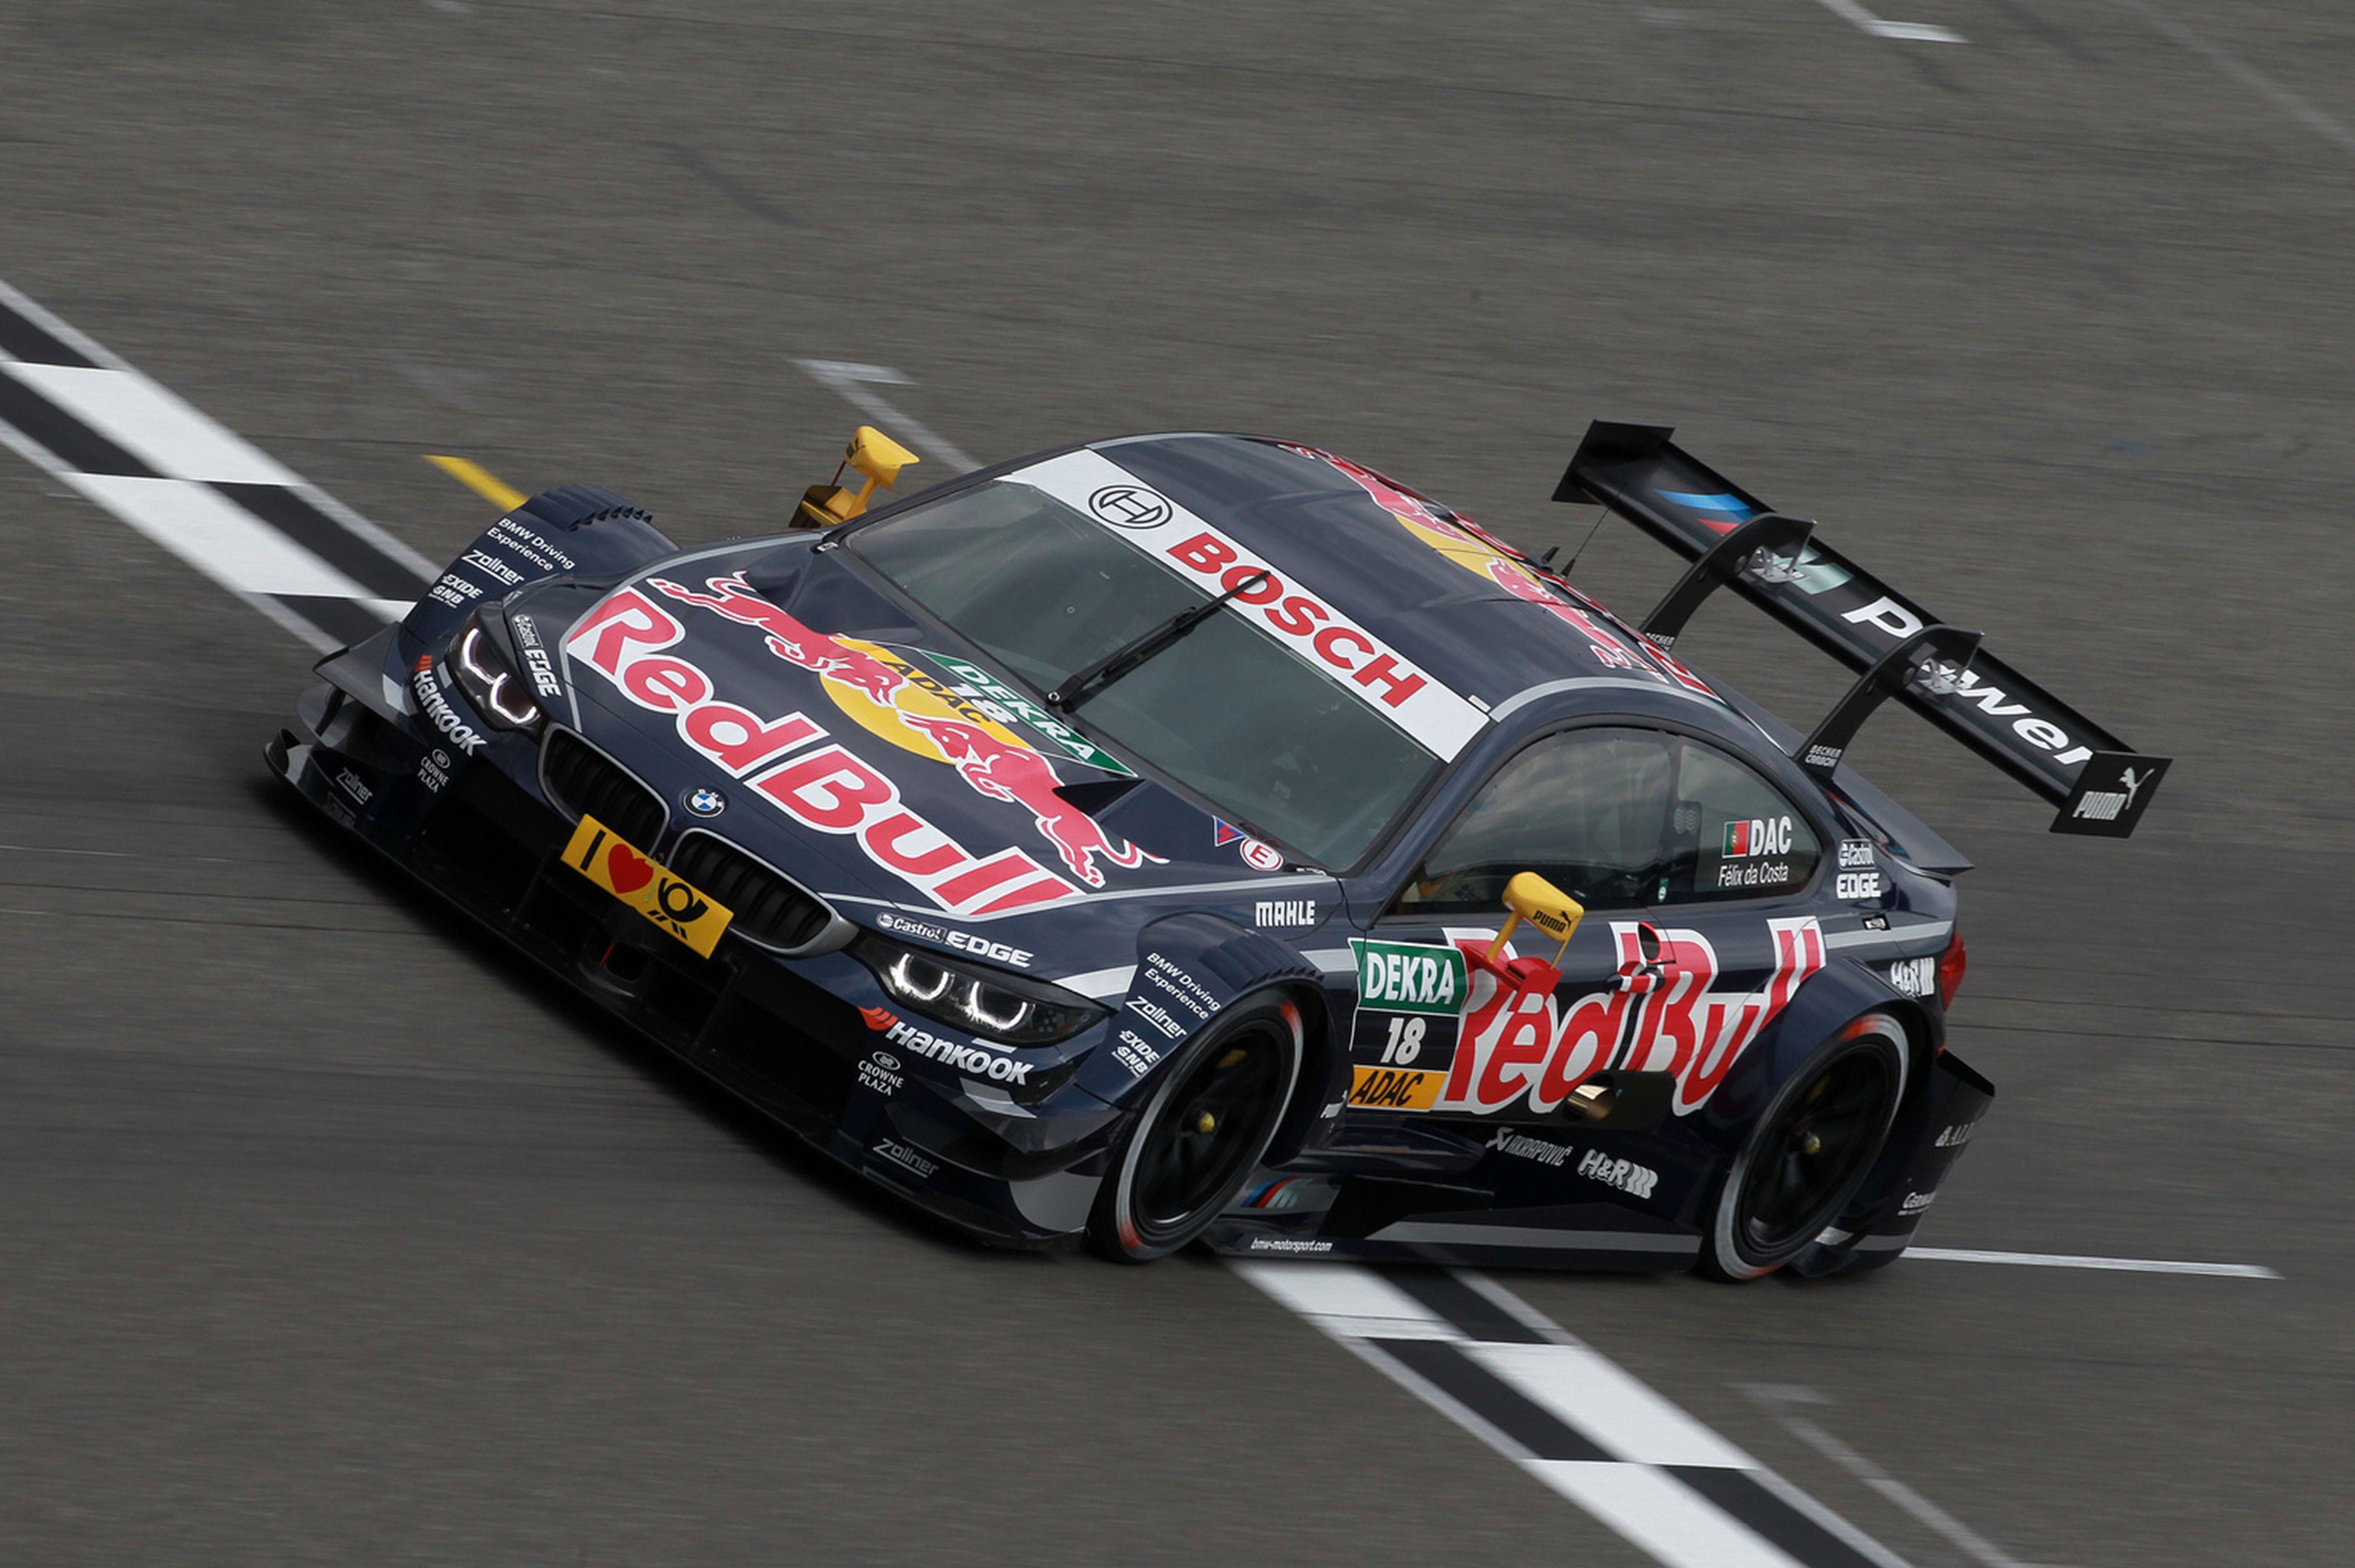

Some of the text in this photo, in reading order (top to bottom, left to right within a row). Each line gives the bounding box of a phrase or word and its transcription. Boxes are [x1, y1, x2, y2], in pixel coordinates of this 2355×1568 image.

[487, 527, 554, 572] Experience
[498, 517, 576, 570] BMW Driving
[443, 574, 483, 599] EXIDE
[462, 549, 525, 585] Zollner
[433, 585, 465, 604] GNB
[1166, 531, 1428, 709] BOSCH
[524, 649, 562, 697] EDGE
[883, 660, 991, 723] ADAC
[1841, 596, 2094, 765] Pwer
[948, 683, 1019, 724] 18
[949, 665, 1096, 761] DEKRA
[420, 756, 451, 787] CROWNE
[566, 587, 1083, 916] Red Bull
[417, 769, 440, 793] PLAZA
[2072, 791, 2127, 820] PUMA
[579, 830, 606, 872] I
[1250, 845, 1272, 865] E
[1749, 816, 1792, 856] DAC
[1718, 862, 1789, 886] Félix da Costa
[1836, 873, 1882, 899] EDGE
[1255, 900, 1316, 927] MAHLE
[1533, 910, 1566, 934] PUMA
[893, 918, 1034, 968] Castrol EDGE
[1145, 968, 1209, 1020] Experience
[1147, 952, 1221, 1012] BMW Driving
[1365, 952, 1455, 1005] DEKRA
[1125, 996, 1187, 1039] Zollner
[1117, 1047, 1149, 1074] GNB
[1119, 1030, 1160, 1063] EXIDE
[1380, 1017, 1427, 1065] 18
[858, 1060, 904, 1089] CROWNE
[858, 1074, 893, 1095] PLAZA
[1349, 1070, 1425, 1107] ADAC
[873, 1138, 938, 1178] Zollner
[1578, 1149, 1644, 1195] H&R
[1251, 1237, 1332, 1253] bmw-motorsport.com
